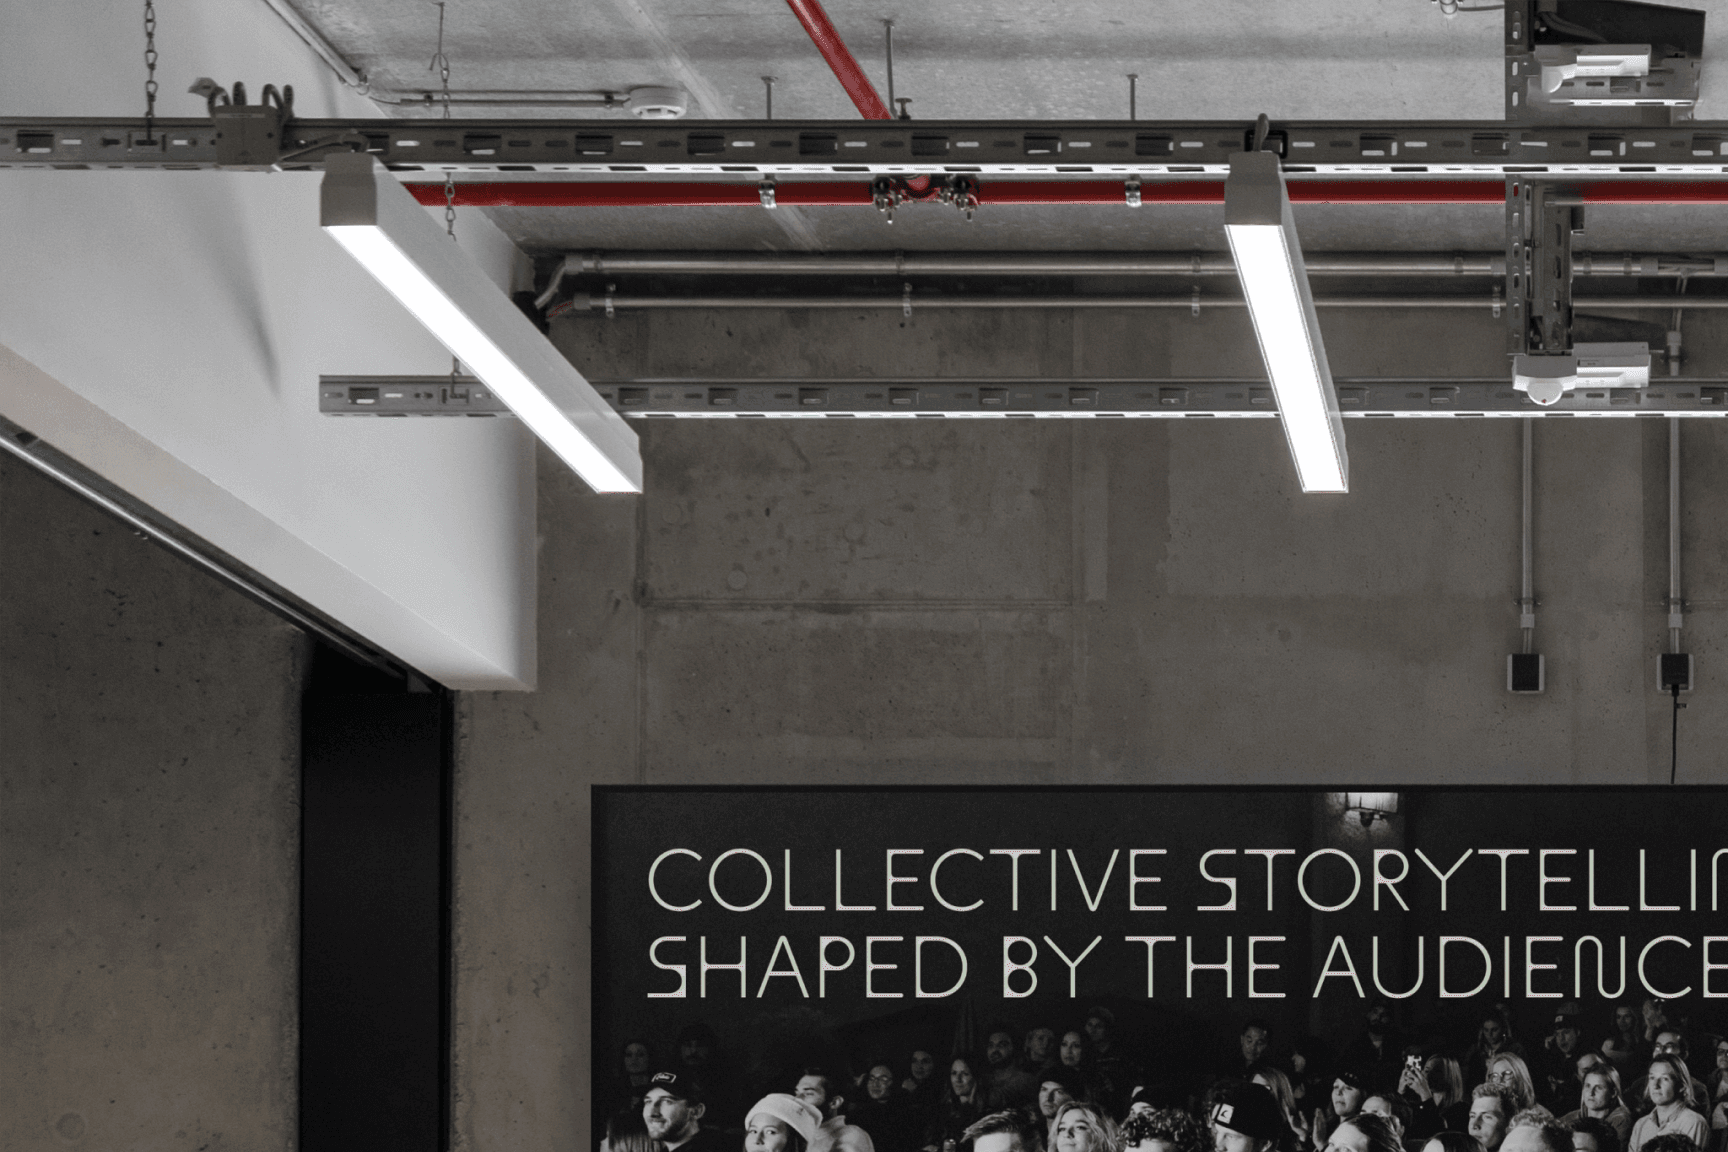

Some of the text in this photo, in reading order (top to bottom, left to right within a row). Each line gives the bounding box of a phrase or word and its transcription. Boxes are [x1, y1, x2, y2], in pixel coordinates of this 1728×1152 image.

[648, 848, 1168, 912] COLLECTIVE
[647, 935, 968, 999] SHAPED
[1003, 935, 1103, 999] BY
[1124, 935, 1287, 999] THE
